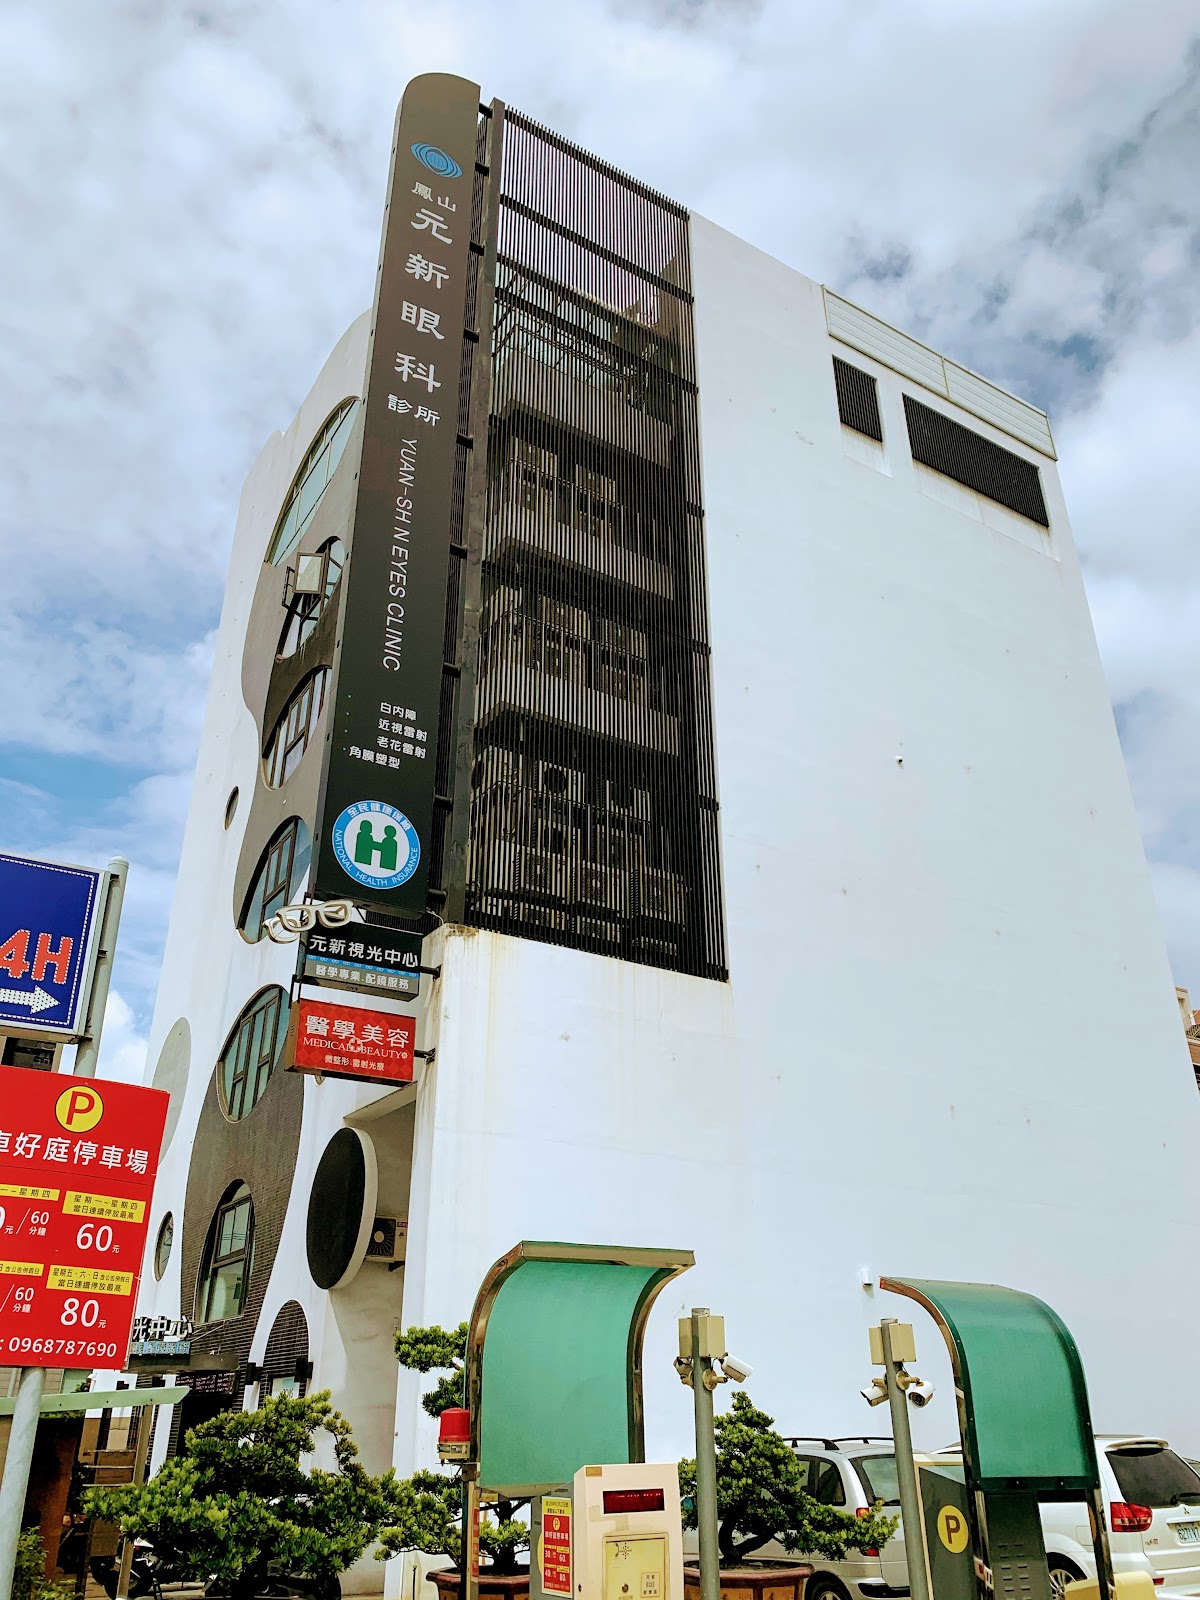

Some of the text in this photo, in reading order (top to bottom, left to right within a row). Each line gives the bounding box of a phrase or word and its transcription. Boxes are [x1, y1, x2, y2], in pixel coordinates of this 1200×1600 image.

[411, 181, 457, 212] 鳳山
[394, 208, 453, 393] 元新眼科
[387, 394, 441, 427] 診所
[389, 545, 409, 598] EYES
[382, 602, 404, 672] CLINIC
[380, 702, 417, 722] 白內障
[378, 718, 428, 743] 近視雷射
[349, 745, 400, 770] 角膜塑型
[377, 736, 427, 760] 老花雷射
[347, 802, 411, 831] 全民健康保險
[335, 829, 418, 886] NATIONAL HEALTH INSURANCE
[309, 934, 418, 968] 元新視光中心
[305, 1015, 409, 1049] 醫學美容
[360, 1045, 401, 1059] BEAUTY
[66, 1091, 95, 1125] P
[31, 1210, 50, 1225] 60
[73, 1204, 135, 1220] 當日連續停放最高
[15, 1286, 35, 1302] 60
[57, 1278, 122, 1293] 當日連續停放最高
[132, 1316, 193, 1340] 光中心
[945, 1515, 960, 1544] P
